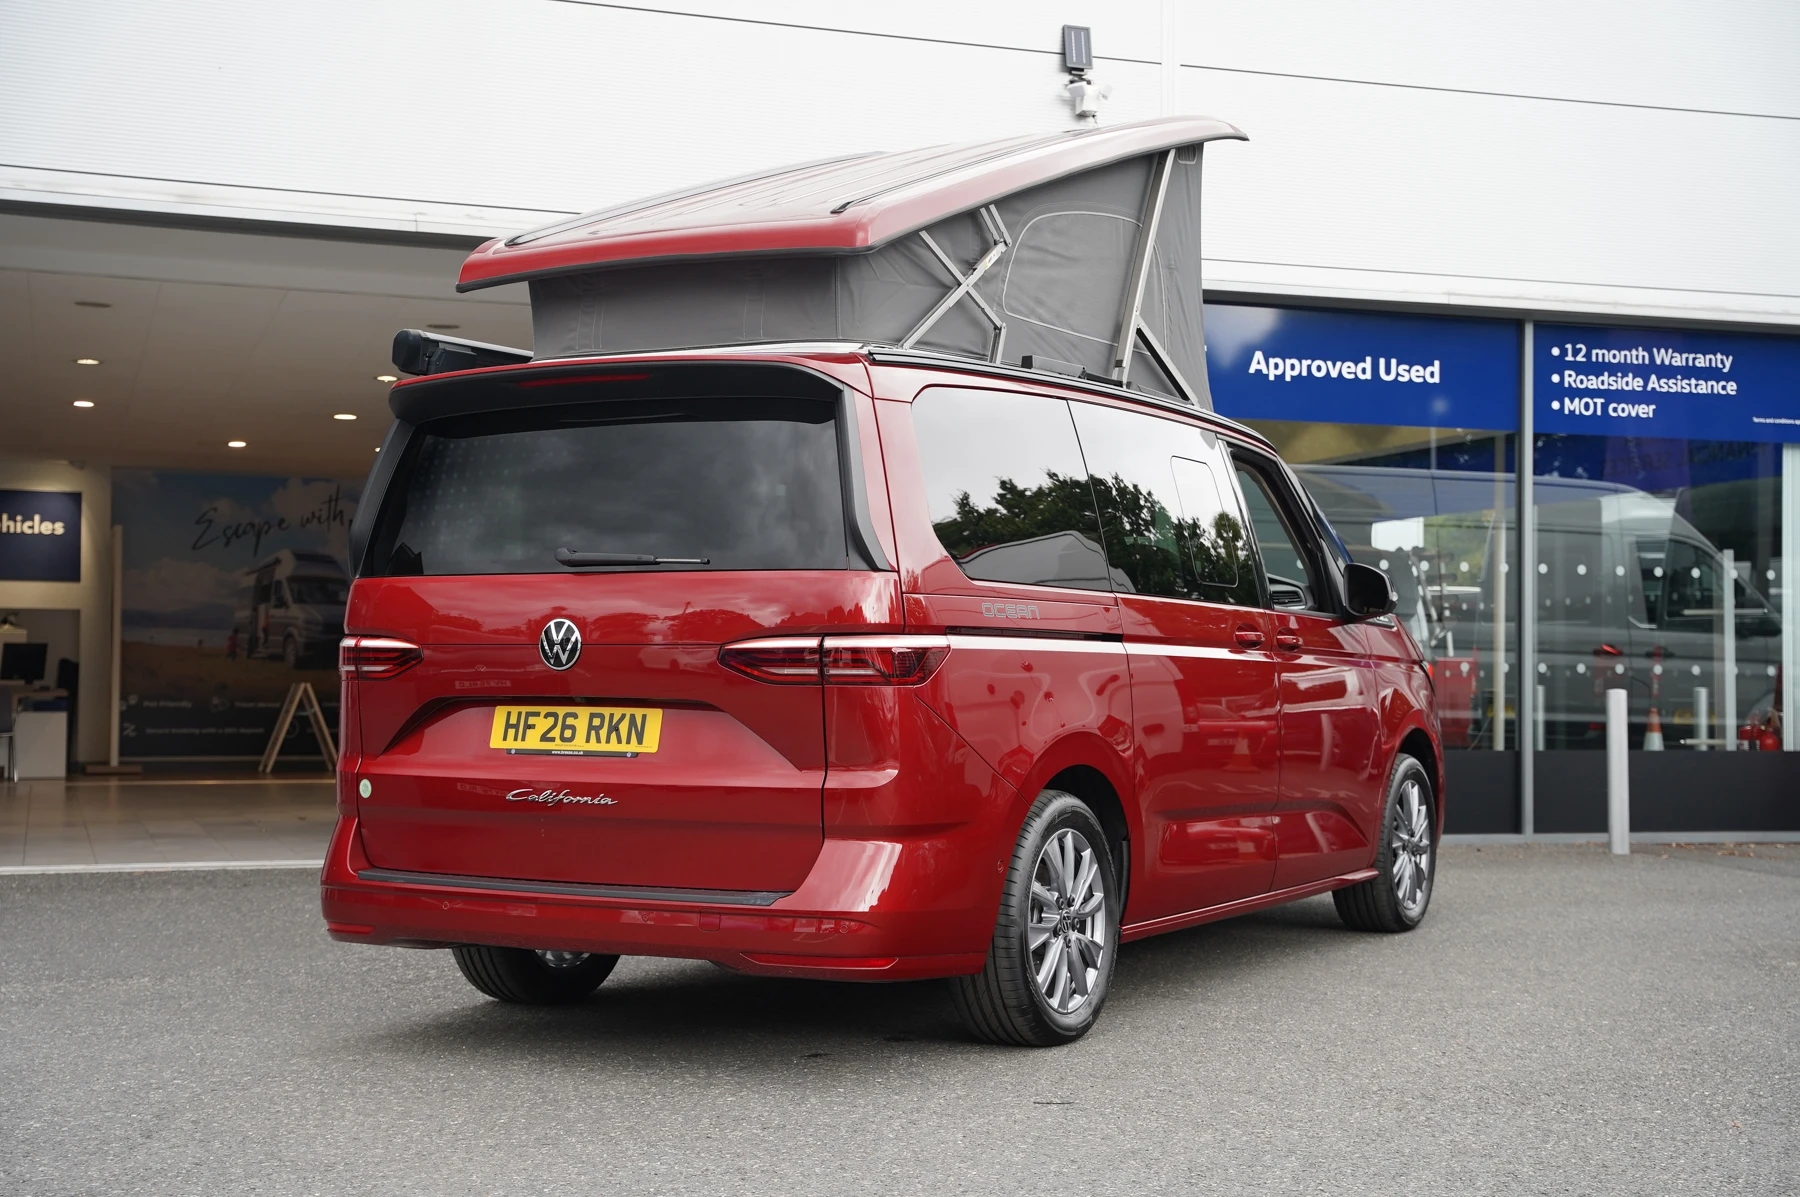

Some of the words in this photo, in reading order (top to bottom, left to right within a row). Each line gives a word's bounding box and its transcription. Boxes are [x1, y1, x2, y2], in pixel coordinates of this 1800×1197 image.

[1248, 350, 1372, 382] Approved
[1379, 357, 1441, 384] Used
[1564, 343, 1588, 362] 12
[1591, 346, 1650, 365] month
[1652, 347, 1733, 373] Warranty
[1563, 370, 1644, 391] Roadside
[1646, 373, 1738, 396] Assistance
[1563, 397, 1606, 417] MOT
[1607, 402, 1657, 418] cover
[0, 512, 66, 536] hicles
[192, 506, 291, 557] Escape
[300, 484, 345, 532] with
[981, 602, 1040, 620] OCEAN
[502, 710, 579, 743] HF26
[585, 712, 648, 746] RKN
[505, 788, 619, 807] California
